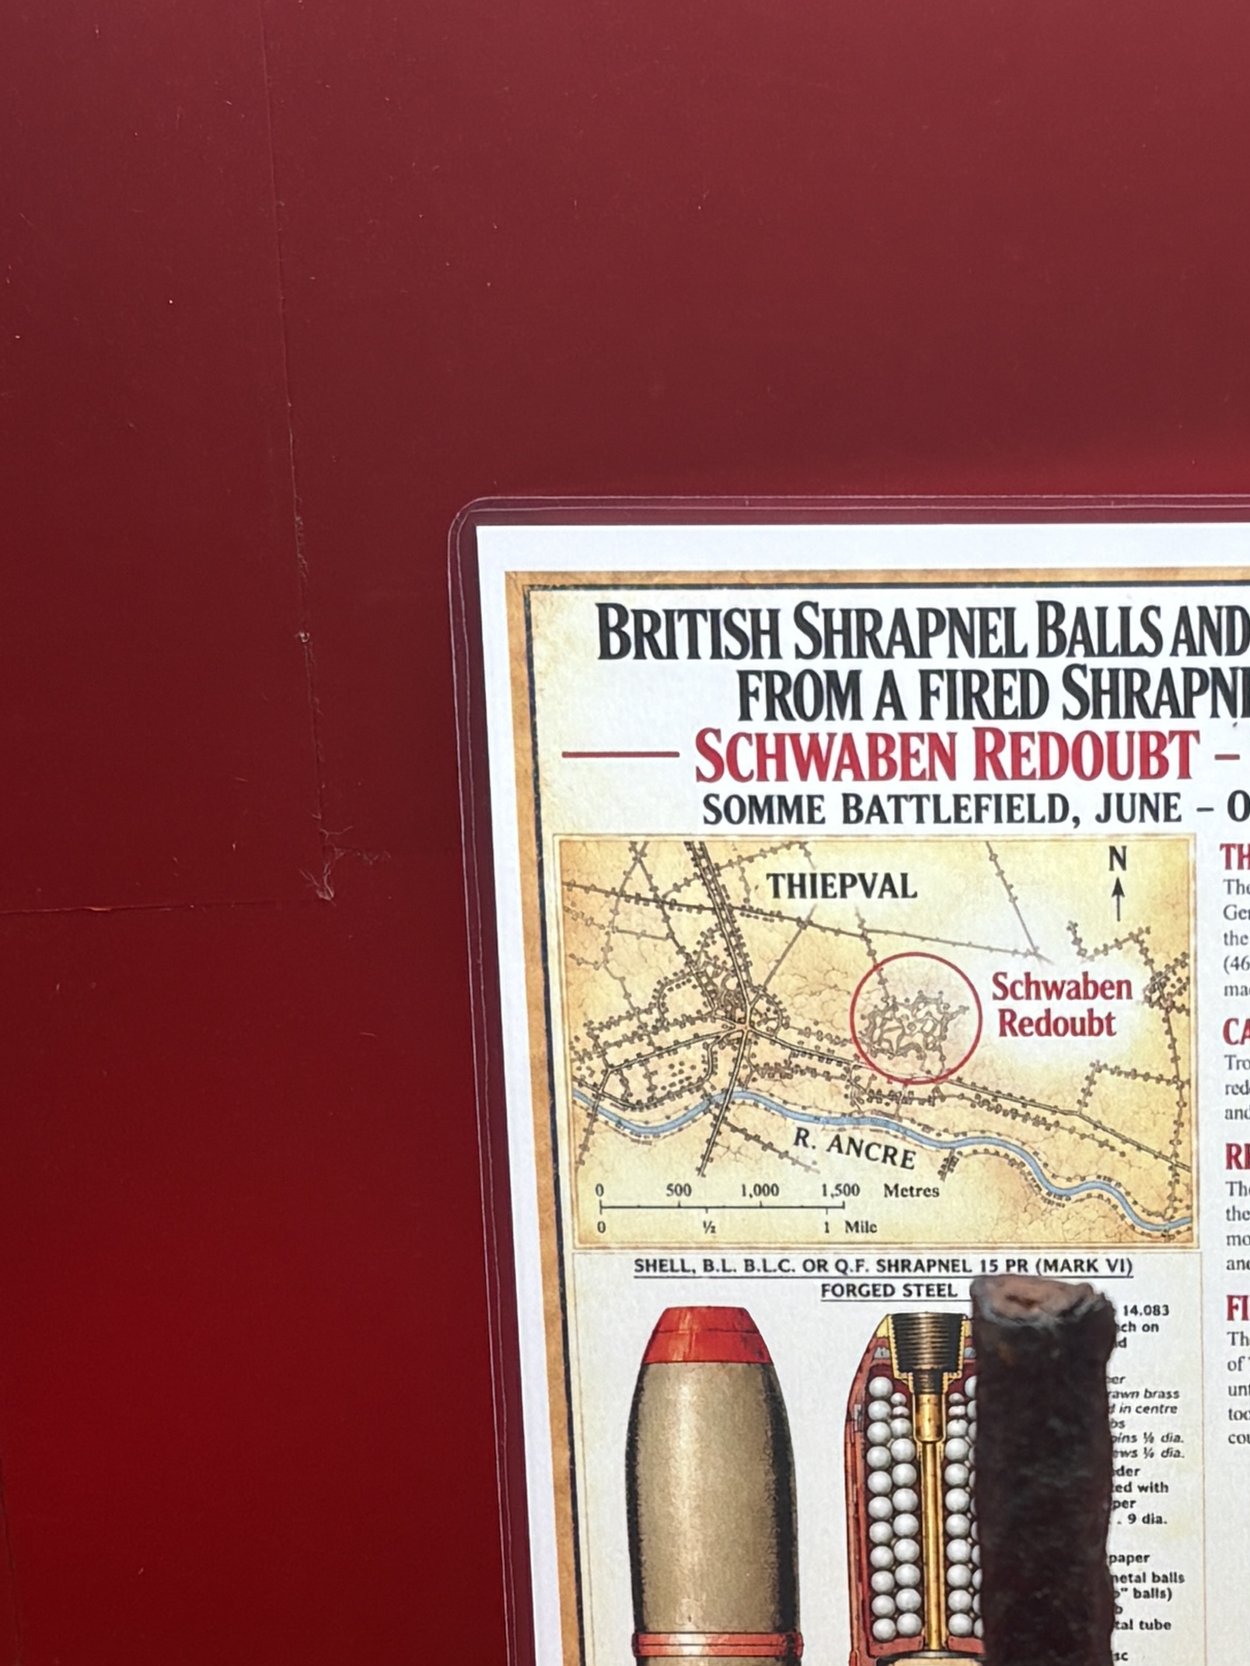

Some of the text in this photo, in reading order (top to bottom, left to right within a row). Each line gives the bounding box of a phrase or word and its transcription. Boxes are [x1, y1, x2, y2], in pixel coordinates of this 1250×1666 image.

[595, 601, 782, 661] BRITISH
[793, 598, 1027, 660] SHRAPNEL
[1036, 599, 1163, 658] BALLS
[1169, 605, 1250, 656] AND
[736, 668, 863, 722] FROM
[872, 669, 907, 720] A
[918, 668, 1049, 720] FIRED
[695, 727, 957, 782] SCHWABEN
[972, 726, 1200, 781] REDOUBT
[703, 792, 825, 824] SOMME
[841, 791, 1079, 829] BATTLEFIELD,
[1095, 792, 1181, 823] JUNE
[1109, 845, 1126, 871] N
[766, 872, 917, 898] THIEPVAL
[992, 969, 1132, 1002] Schwaben
[998, 1005, 1116, 1040] Redoubt
[793, 1127, 917, 1170] R. ANCRE
[595, 1183, 939, 1198] 0 500 1,000 1,500 Metres
[597, 1221, 605, 1233] 0
[824, 1221, 829, 1233] 1
[845, 1220, 877, 1233] Mile
[634, 1257, 1132, 1276] SHELL, B.L. B.L.C. OR Q.F. SHRAPNEL 15 PR (MARK VI)
[821, 1283, 957, 1297] FORGED STEEL
[1123, 1304, 1169, 1316] 14.083
[1142, 1323, 1159, 1332] on
[1144, 1388, 1180, 1399] brass
[1119, 1403, 1131, 1413] in
[1135, 1404, 1178, 1414] centre
[1161, 1433, 1184, 1443] dia.
[1161, 1448, 1185, 1458] dia.
[1138, 1481, 1169, 1493] with
[1142, 1513, 1167, 1524] dia.
[1152, 1572, 1185, 1583] balls
[1133, 1588, 1172, 1601] balls)
[1139, 1619, 1172, 1630] tube
